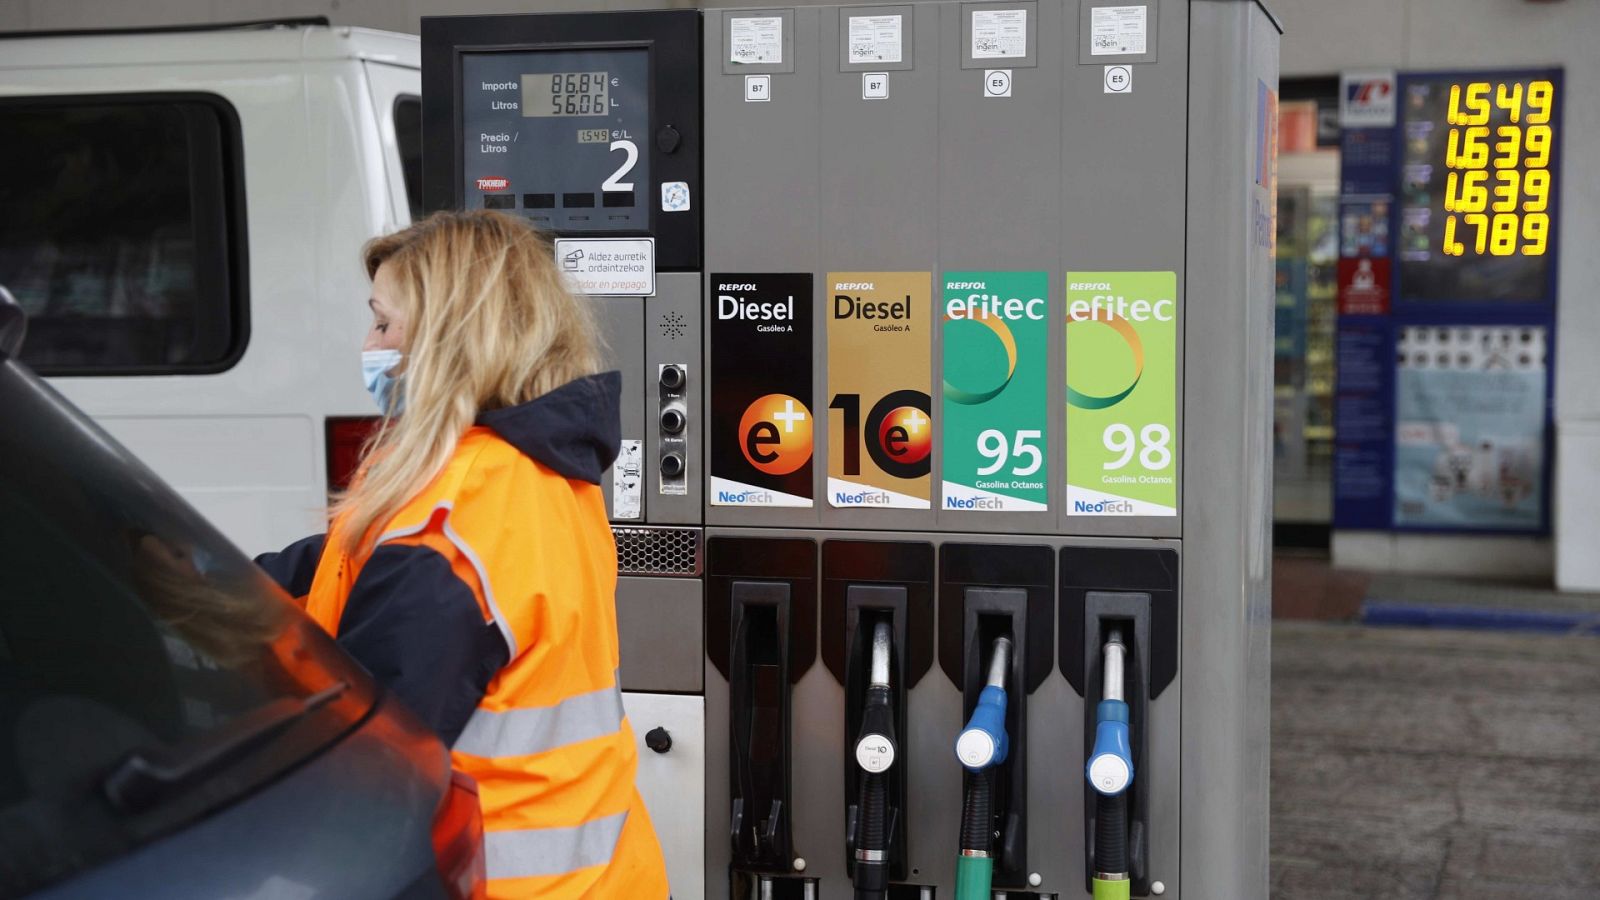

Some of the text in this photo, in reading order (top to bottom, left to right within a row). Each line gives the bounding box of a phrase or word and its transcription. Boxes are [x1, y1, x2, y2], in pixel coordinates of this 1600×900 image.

[992, 79, 1003, 87] E5
[1112, 75, 1123, 83] E5
[482, 81, 518, 92] Importe
[610, 78, 620, 86] €
[752, 84, 763, 92] B7
[870, 82, 881, 90] B7
[492, 100, 518, 109] Litros
[480, 133, 510, 142] Precio
[481, 144, 507, 153] Litros
[601, 140, 639, 192] 2
[1443, 213, 1549, 257] 1.789
[588, 252, 647, 261] Aldez aurretik
[588, 263, 645, 272] ordaintzekoa
[611, 281, 647, 290] prepago
[718, 283, 757, 291] REPSOL
[835, 283, 875, 291] REPSOL
[946, 282, 986, 290] REPSOL
[1070, 282, 1112, 291] REPSOL
[718, 295, 793, 320] Diesel
[834, 295, 910, 319] Diesel
[946, 294, 1044, 320] efitec
[1069, 295, 1173, 322] efitec
[757, 324, 793, 332] Gasóleo A
[873, 324, 911, 332] Gasóleo A
[1102, 423, 1171, 471] 98
[976, 429, 1043, 476] 95
[1102, 475, 1172, 484] Gasolina Octanos
[975, 480, 1044, 489] Gasolina Octanos
[719, 491, 772, 503] NeoTech
[836, 491, 890, 504] NeoTech
[947, 495, 1003, 509] NeoTech
[1075, 499, 1133, 513] NeoTech
